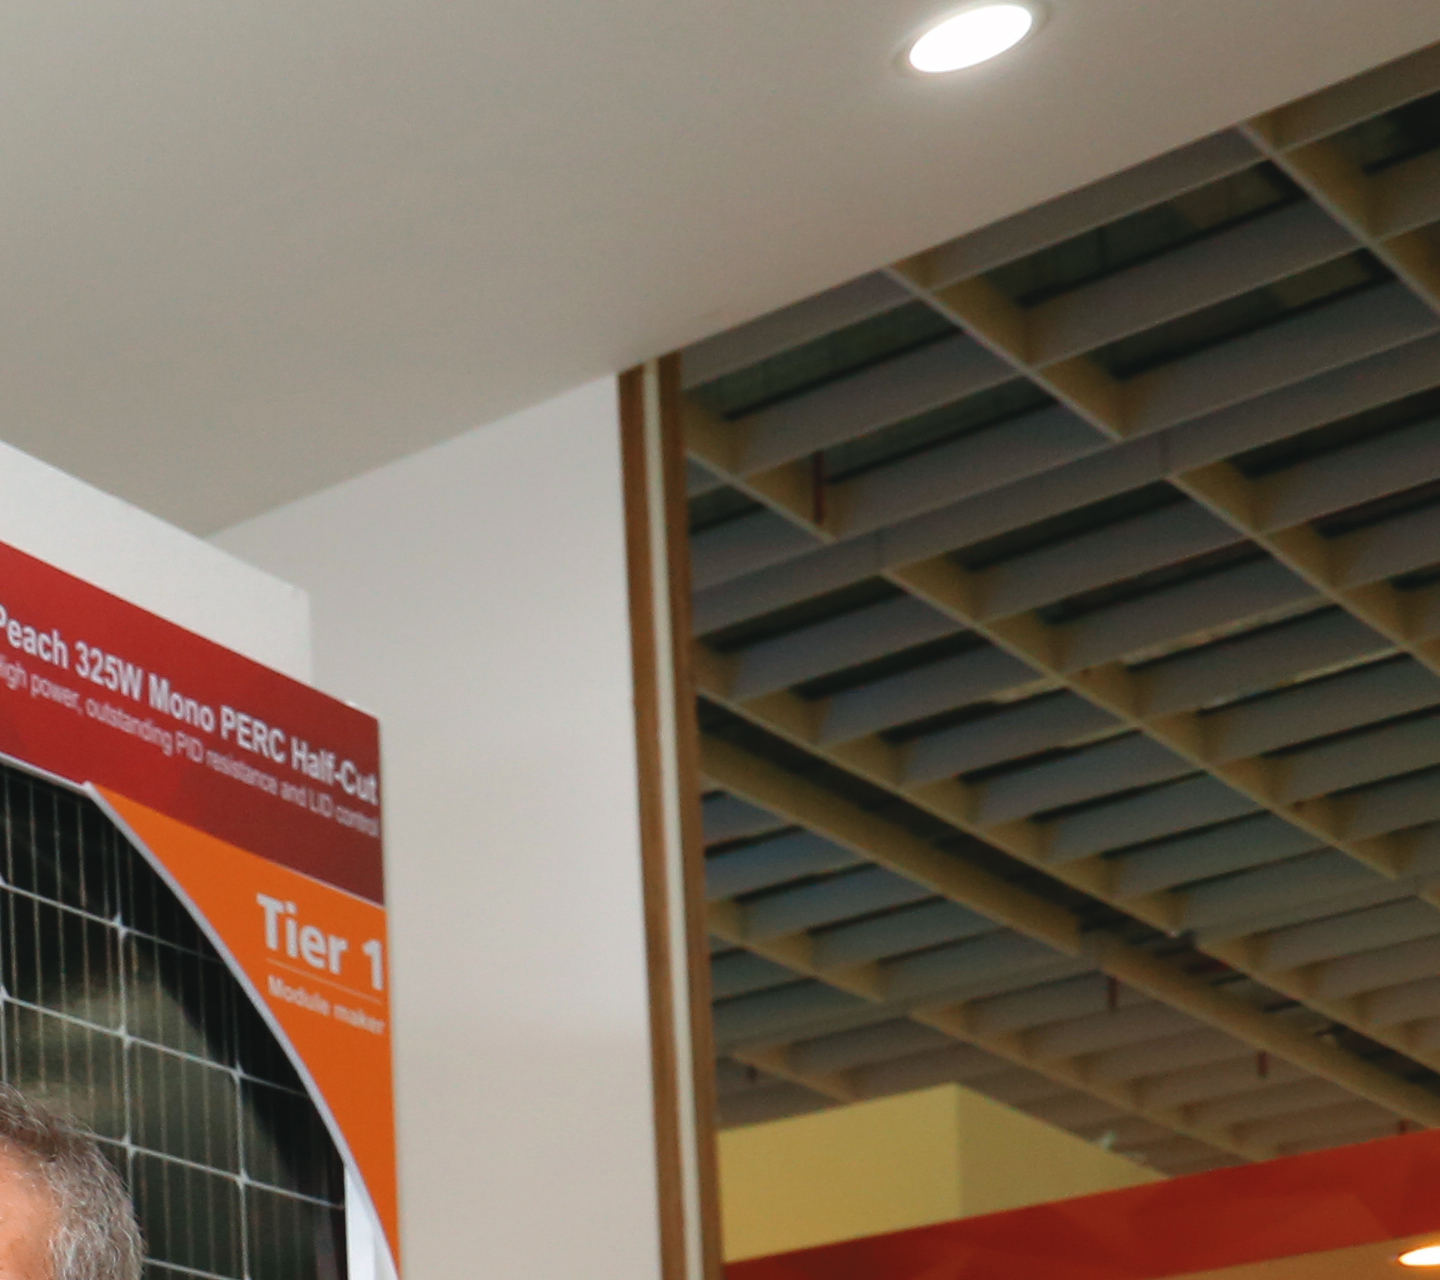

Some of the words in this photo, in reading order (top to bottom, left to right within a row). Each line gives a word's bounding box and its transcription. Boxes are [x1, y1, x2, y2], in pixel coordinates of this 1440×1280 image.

[75, 640, 143, 701] 325W
[148, 672, 215, 733] Mono
[220, 704, 287, 764] PERC
[290, 736, 379, 806] Half-Cut
[85, 697, 175, 757] outstanding
[175, 730, 205, 764] PID
[256, 892, 349, 975] Tier
[362, 939, 384, 991] 1
